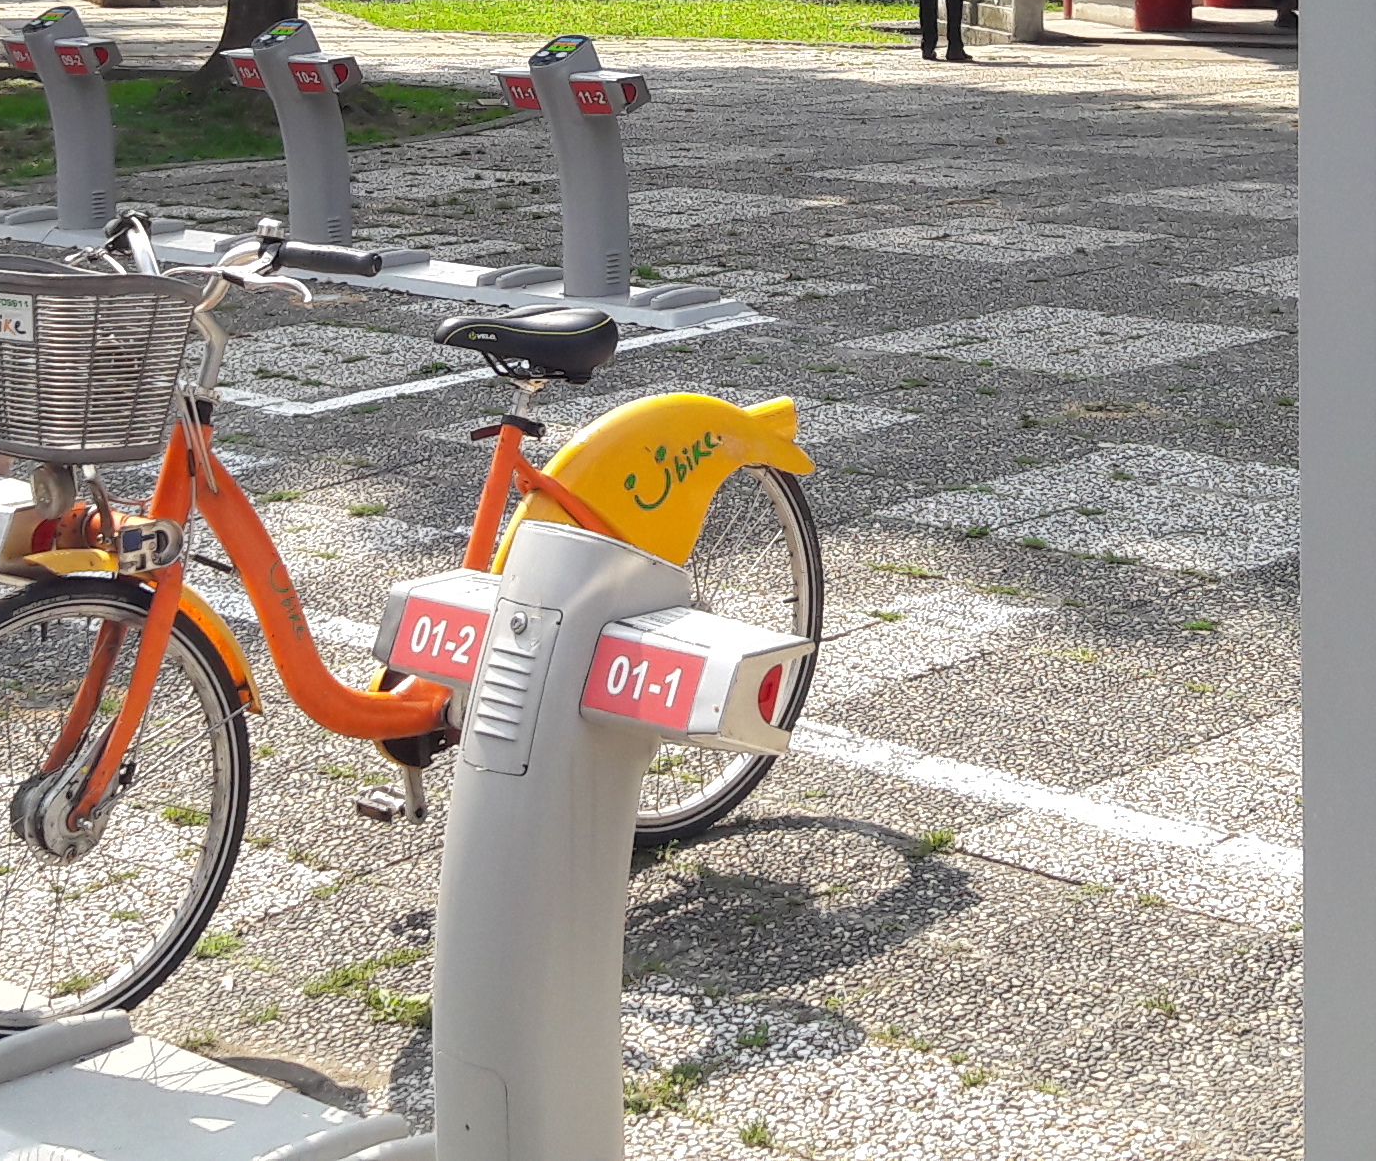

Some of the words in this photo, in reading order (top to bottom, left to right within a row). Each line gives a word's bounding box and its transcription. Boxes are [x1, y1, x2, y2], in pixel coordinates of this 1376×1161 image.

[296, 71, 321, 84] 10-2
[577, 90, 607, 105] 11-2
[410, 615, 476, 665] 01-2
[606, 655, 684, 708] 01-1
